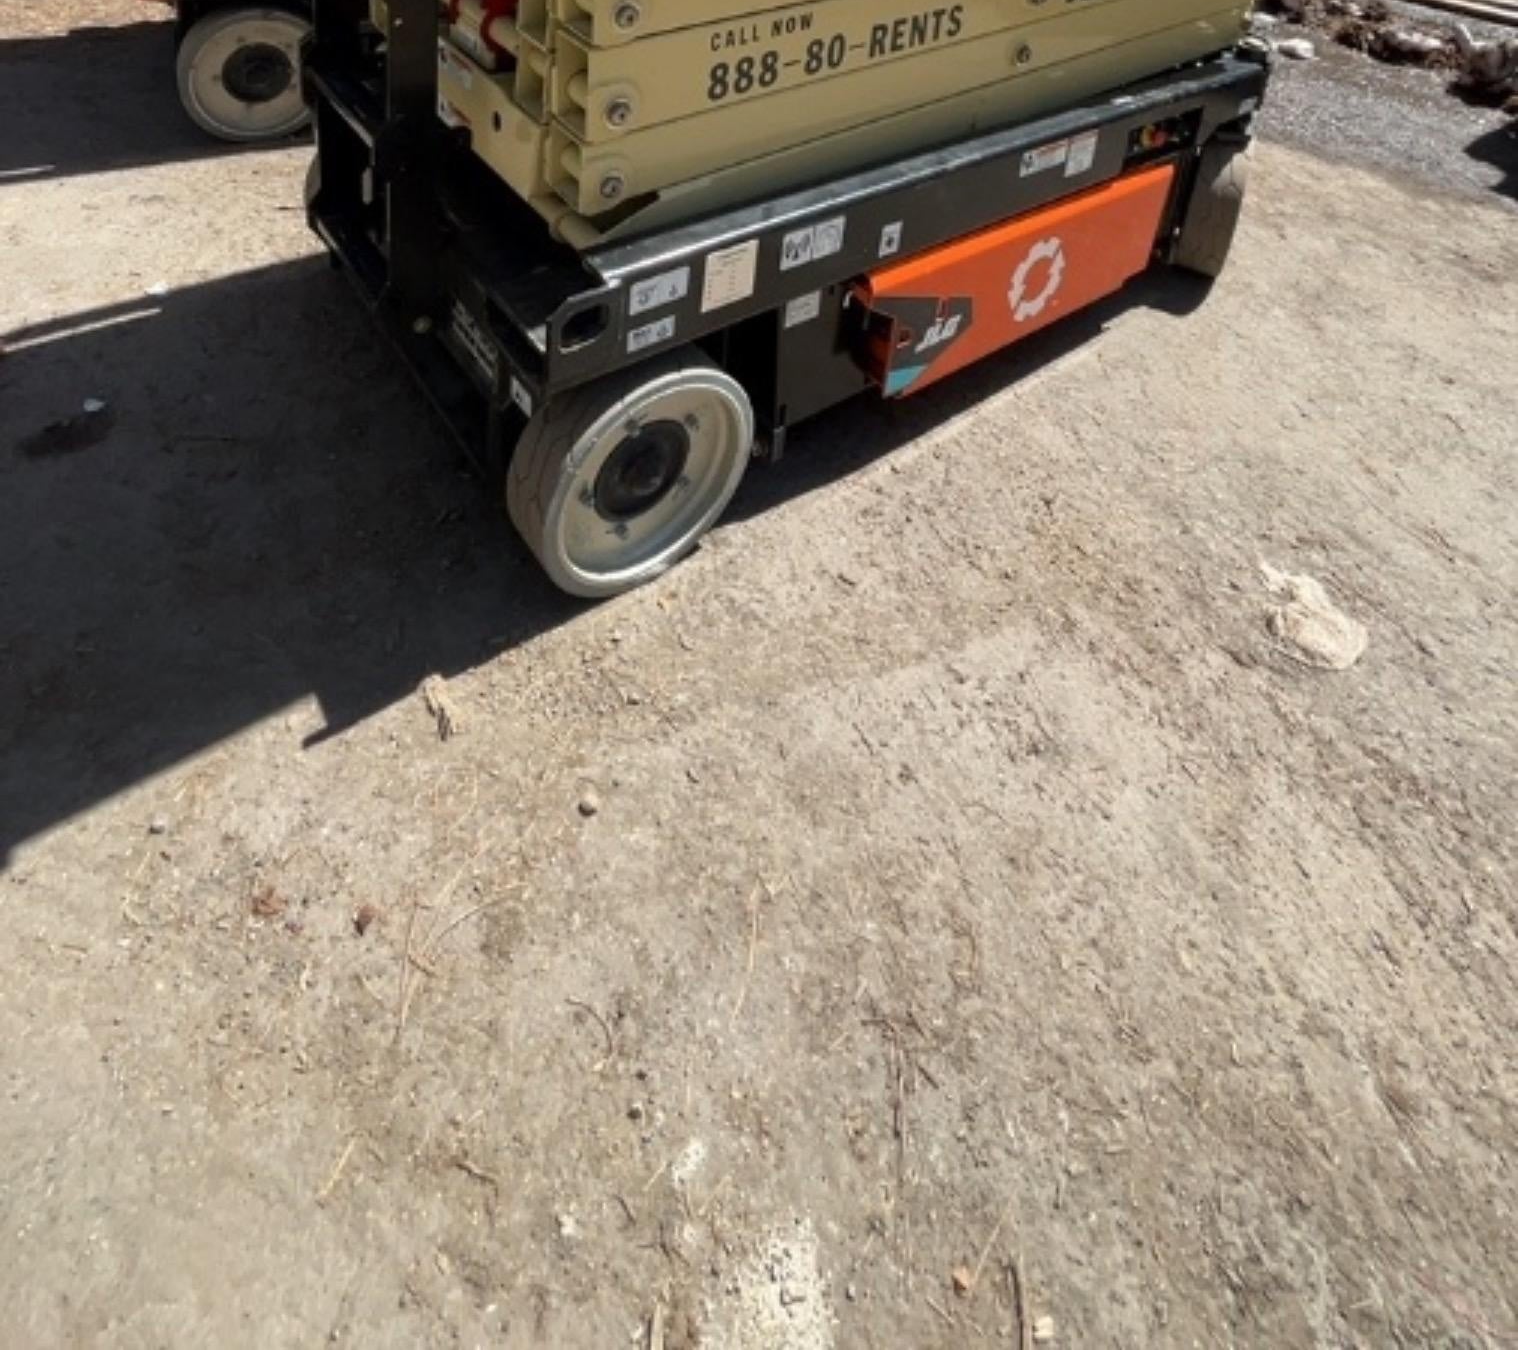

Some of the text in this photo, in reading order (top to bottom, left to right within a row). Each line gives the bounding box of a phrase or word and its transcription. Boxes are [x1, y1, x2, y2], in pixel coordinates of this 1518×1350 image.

[710, 12, 814, 52] CALL NOW
[707, 4, 964, 101] 888-80-RENTS
[914, 314, 962, 354] JLG
